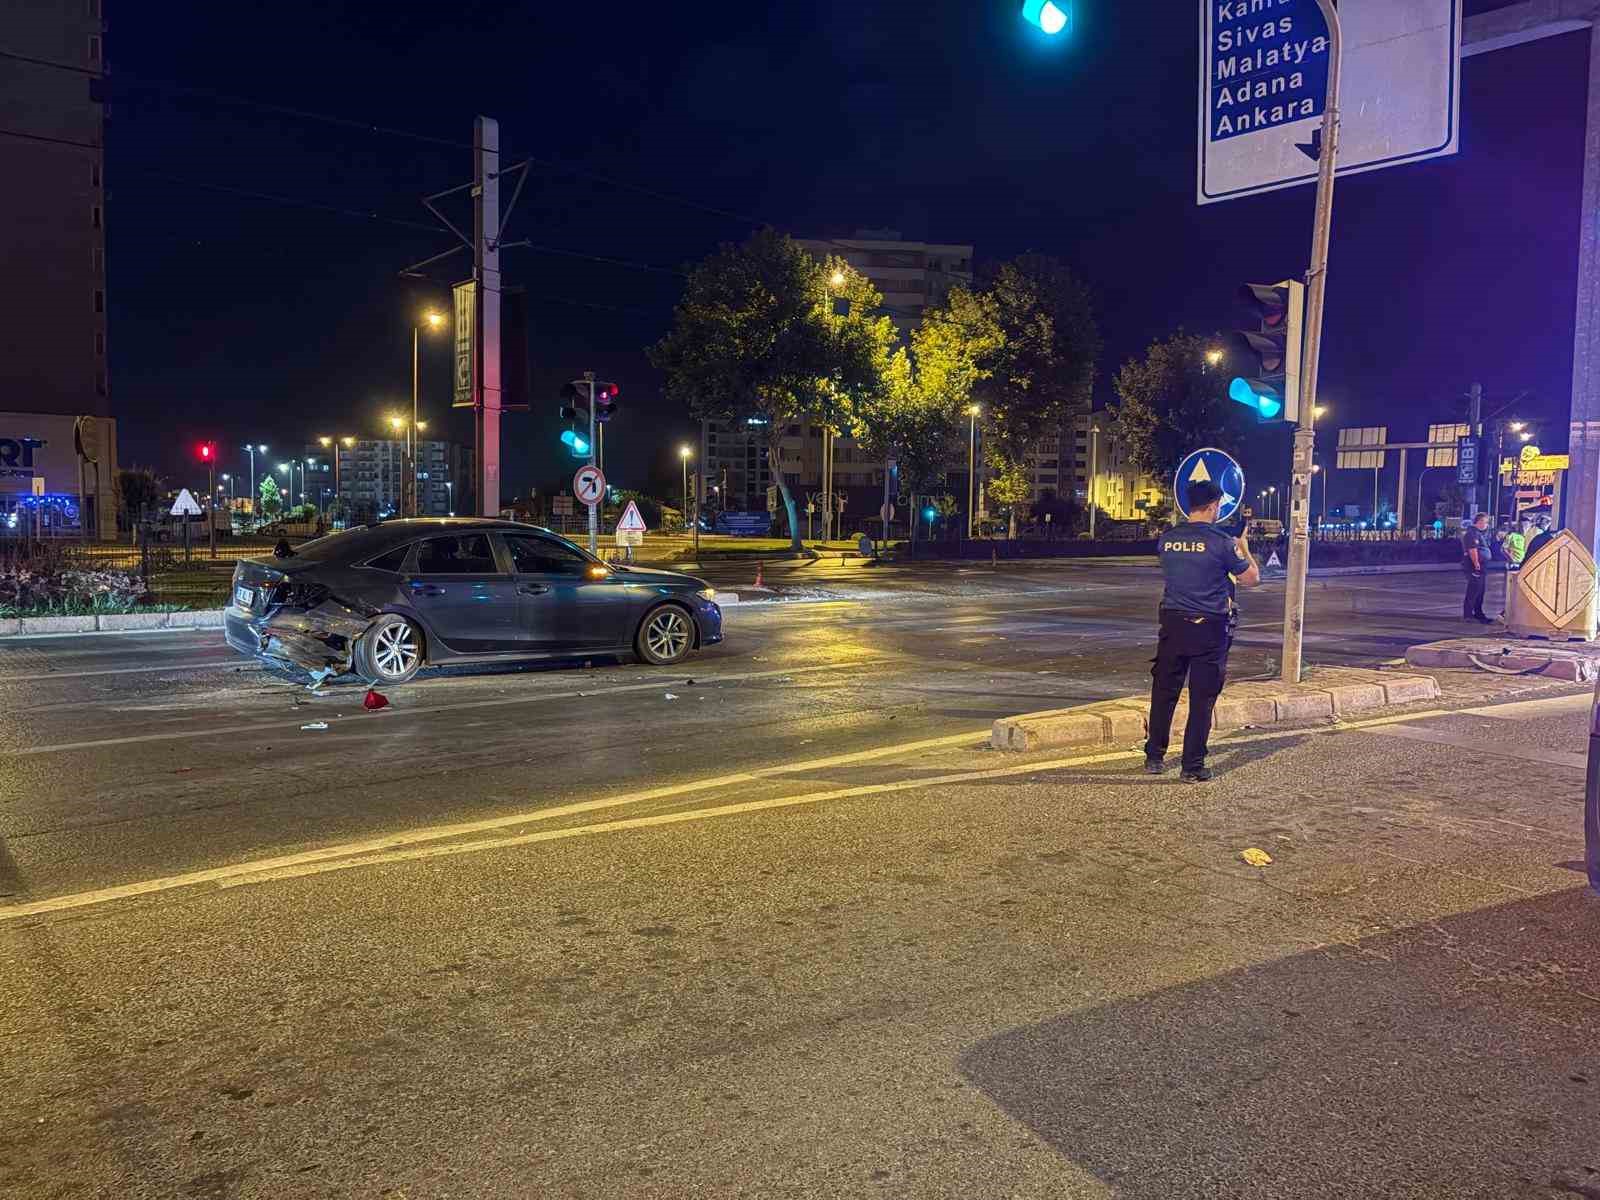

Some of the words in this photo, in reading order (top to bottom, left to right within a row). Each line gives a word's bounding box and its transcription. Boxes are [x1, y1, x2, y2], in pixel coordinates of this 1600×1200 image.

[1218, 17, 1292, 51] Sivas
[1218, 36, 1326, 80] Malatya
[1216, 72, 1303, 108] Adana
[1216, 98, 1314, 136] Ankara
